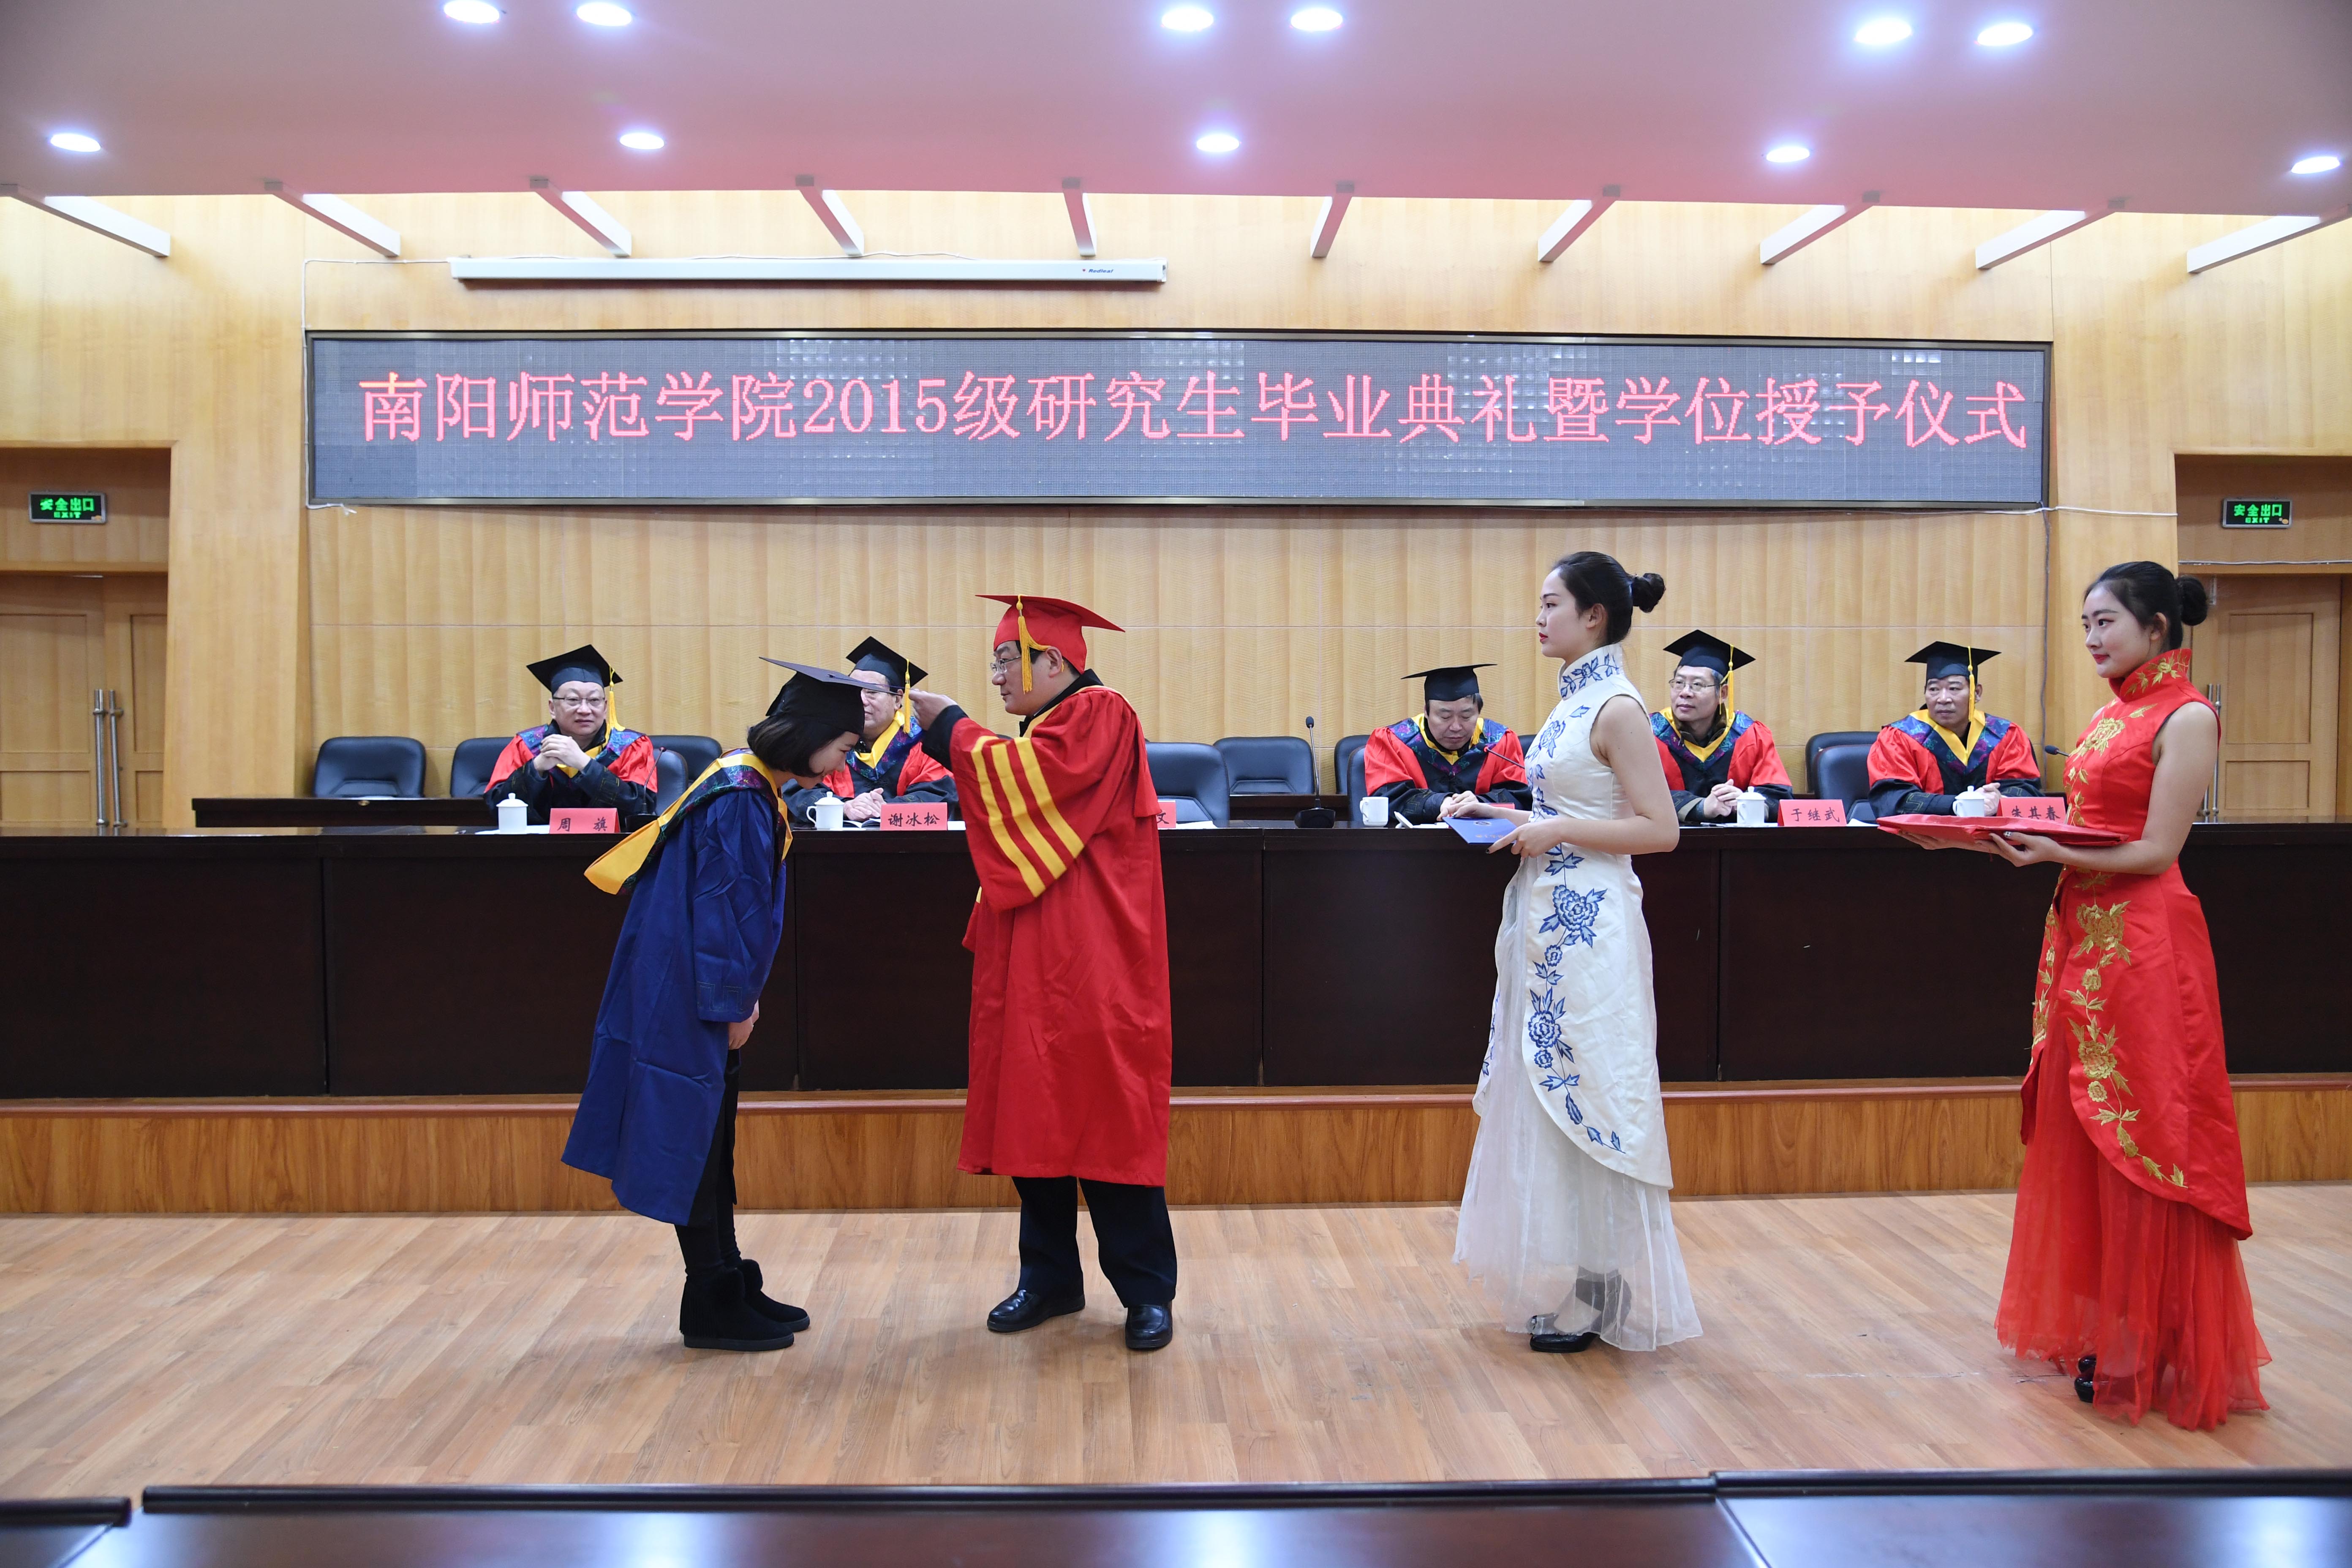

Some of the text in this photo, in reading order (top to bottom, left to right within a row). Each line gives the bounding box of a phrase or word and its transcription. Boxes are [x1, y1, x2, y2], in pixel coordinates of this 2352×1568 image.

[359, 370, 2026, 448] 南阳师范学院2015级研究生毕业典礼暨学位授予仪式
[40, 497, 95, 512] 安全出口
[2234, 504, 2282, 517] 安全出口
[888, 812, 940, 827] 谢冰松
[1791, 807, 1840, 822] 于继武
[2011, 805, 2061, 821] 朱其春
